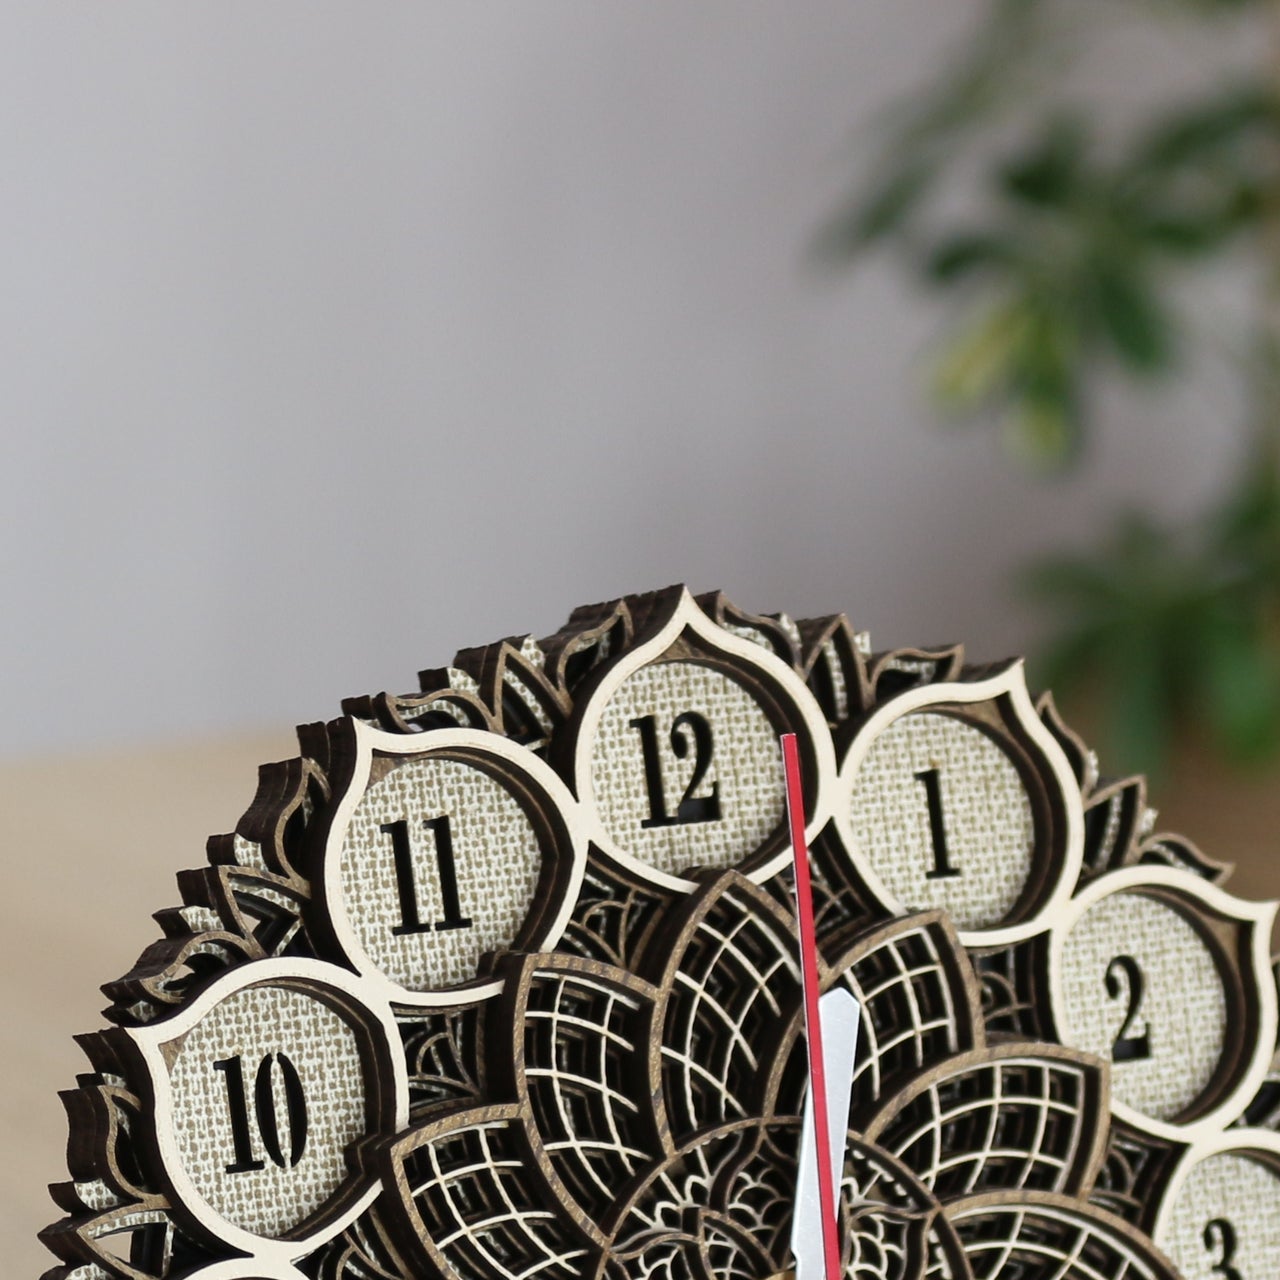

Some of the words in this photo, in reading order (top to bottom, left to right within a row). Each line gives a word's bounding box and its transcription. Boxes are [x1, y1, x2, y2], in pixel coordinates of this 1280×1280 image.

[630, 712, 721, 828] 12
[916, 770, 959, 879] 1
[381, 816, 471, 935] 11
[1104, 956, 1150, 1061] 2
[212, 1053, 307, 1173] 10
